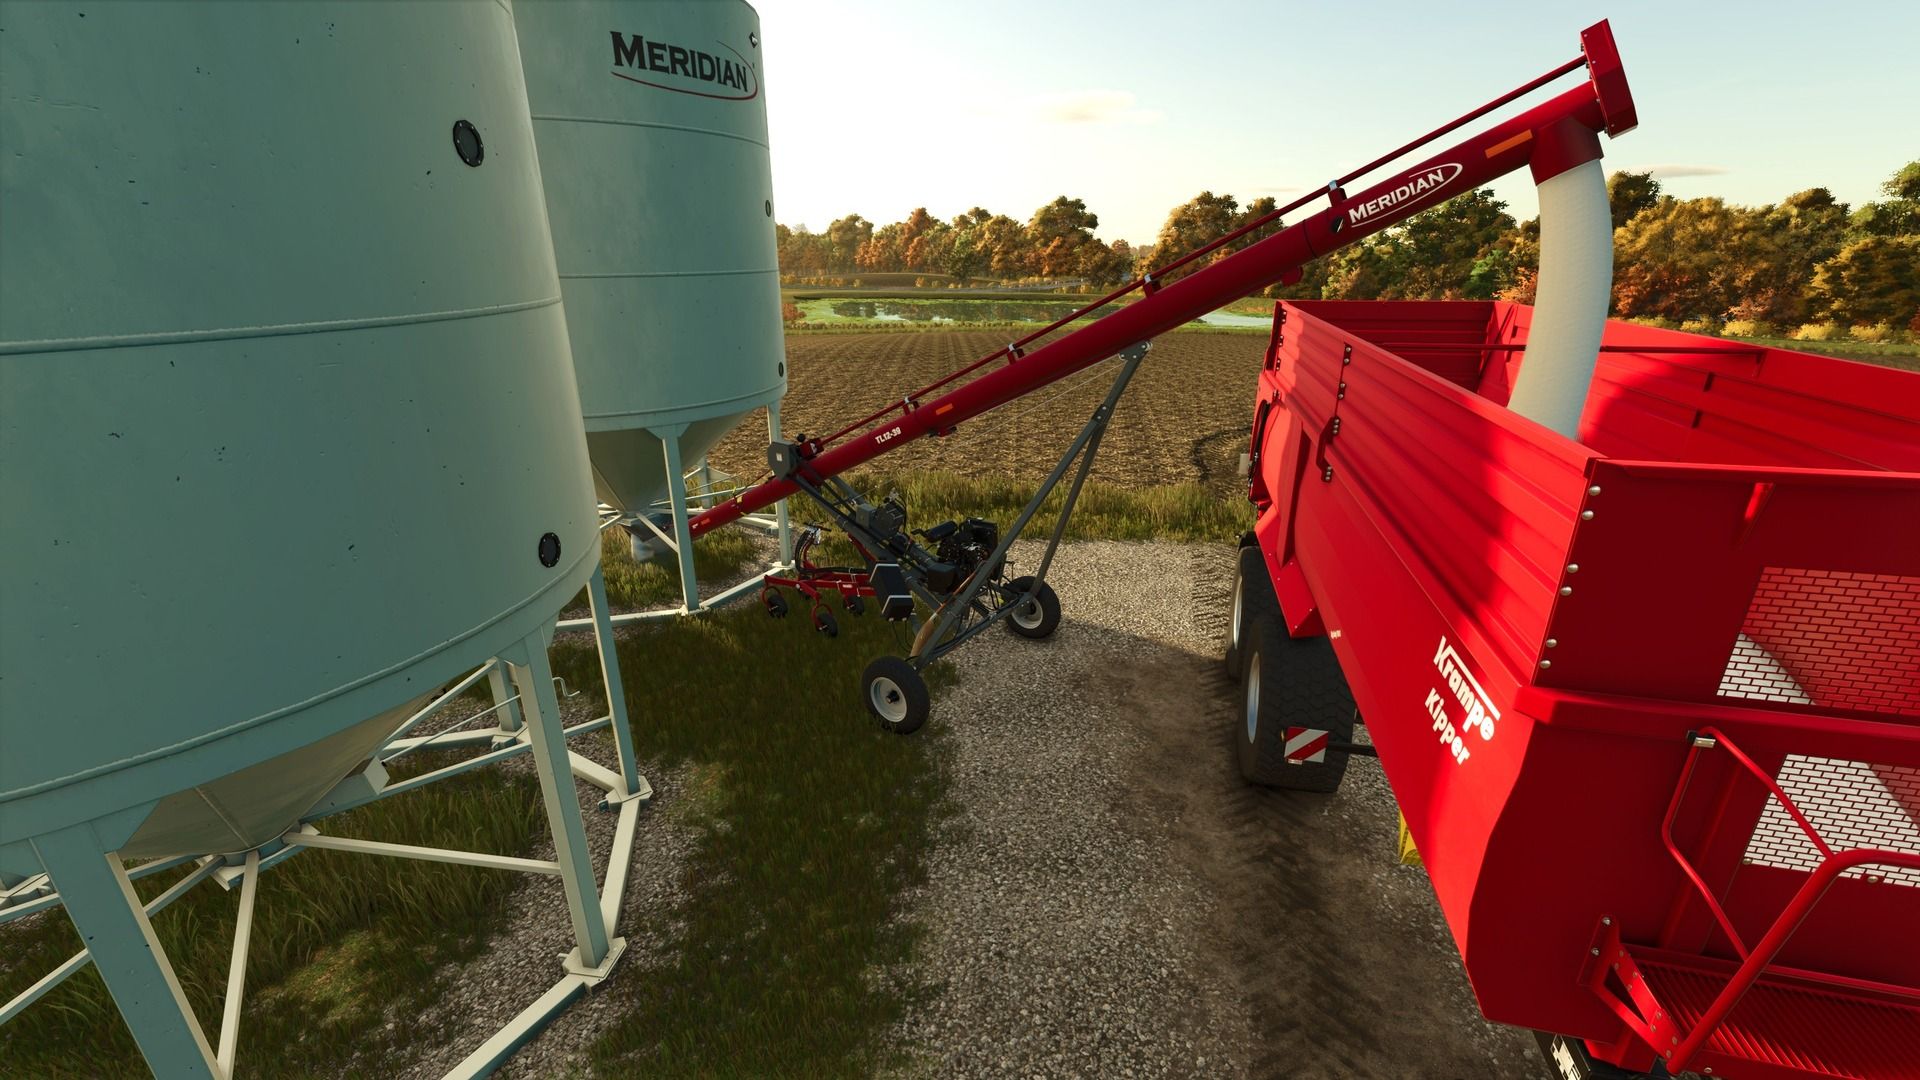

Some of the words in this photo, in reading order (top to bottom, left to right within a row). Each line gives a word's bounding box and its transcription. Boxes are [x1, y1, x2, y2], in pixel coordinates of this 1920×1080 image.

[610, 31, 748, 92] MERIDIAN
[1348, 169, 1445, 224] MERIDIAN
[1433, 635, 1500, 741] Krampe
[1424, 687, 1470, 765] Kipper
